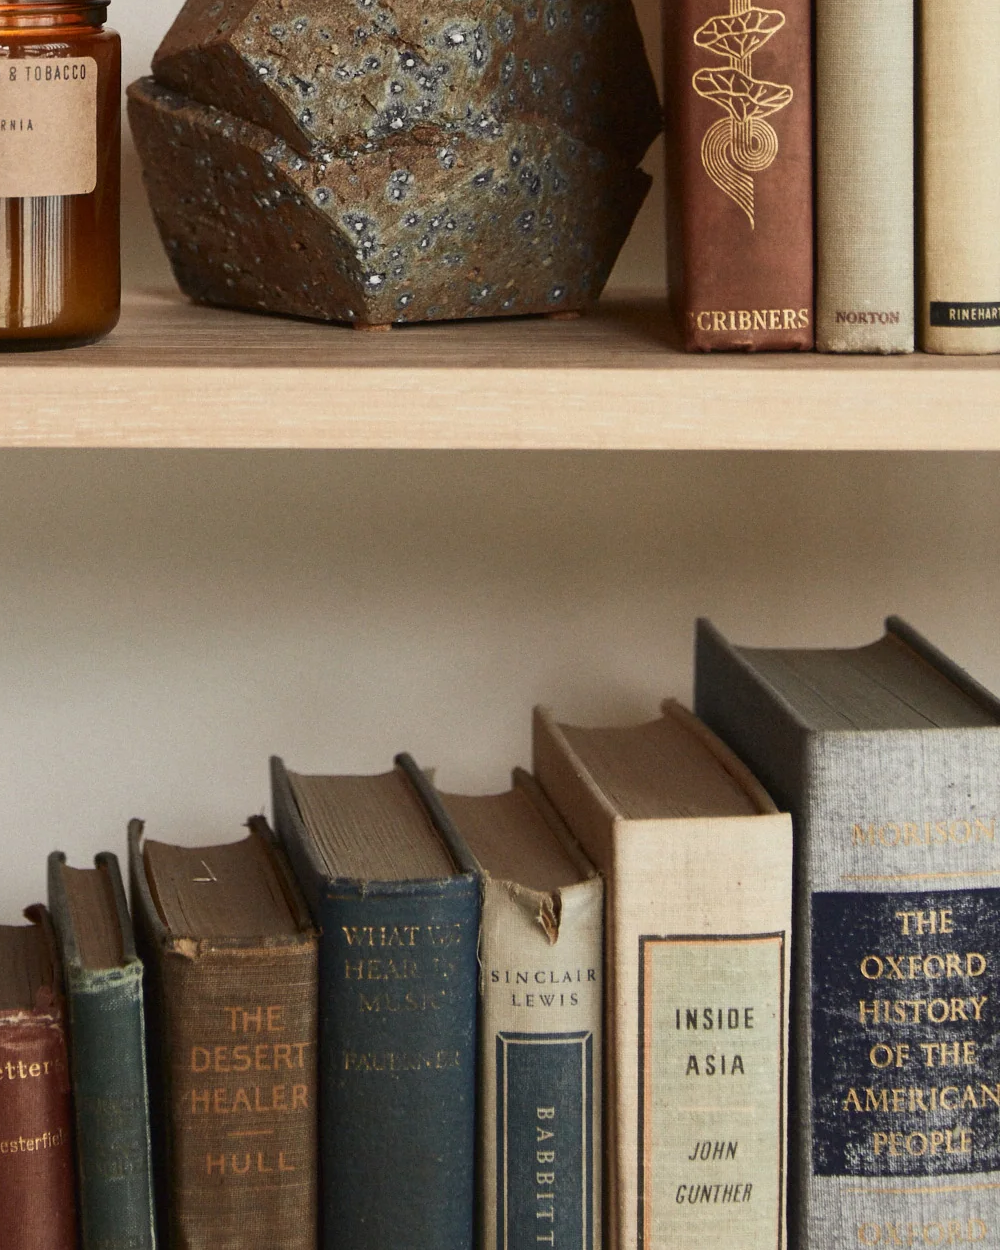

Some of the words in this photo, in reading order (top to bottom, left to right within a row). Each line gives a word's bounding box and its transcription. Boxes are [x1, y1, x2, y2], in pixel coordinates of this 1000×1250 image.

[9, 66, 17, 81] &
[26, 64, 86, 81] TOBACCO
[690, 308, 809, 331] CRIBNERS
[834, 311, 900, 325] NORTON
[851, 817, 997, 848] MORISON
[341, 924, 420, 947] WHAT
[896, 910, 953, 936] THE
[491, 969, 597, 985] SINCLAIR
[860, 953, 987, 980] OXFORD
[511, 993, 579, 1007] LEWIS
[859, 997, 988, 1024] HISTORY
[224, 1005, 285, 1033] THE
[675, 1007, 755, 1030] INSIDE
[191, 1042, 312, 1072] DESERT
[686, 1055, 746, 1076] ASIA
[870, 1044, 910, 1068] OF
[920, 1041, 977, 1067] THE
[192, 1084, 309, 1114] HEALER
[843, 1083, 1000, 1112] AMERICAN
[688, 1142, 738, 1161] JOHN
[873, 1129, 975, 1156] PEOPLE
[206, 1152, 296, 1175] HULL
[536, 1106, 555, 1247] BABBITT
[675, 1185, 752, 1204] GUNTHER
[857, 1217, 988, 1247] OXFORD
